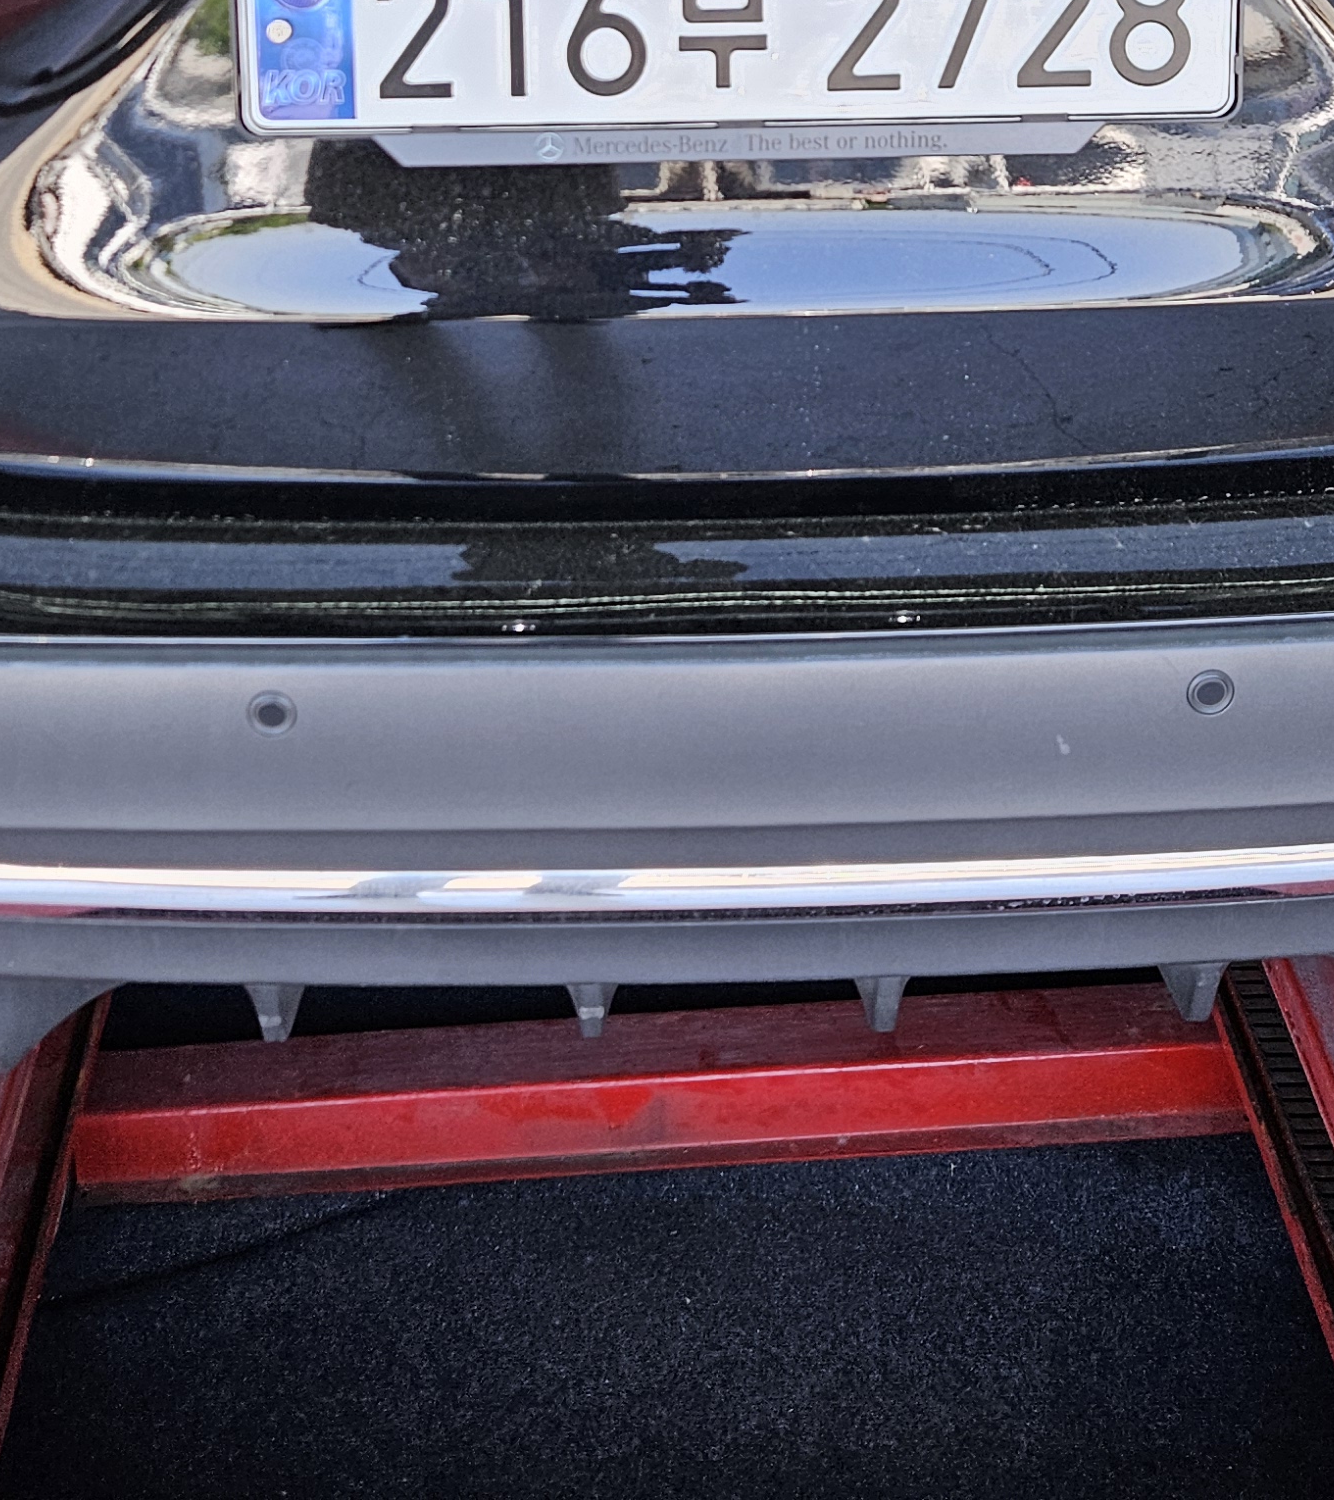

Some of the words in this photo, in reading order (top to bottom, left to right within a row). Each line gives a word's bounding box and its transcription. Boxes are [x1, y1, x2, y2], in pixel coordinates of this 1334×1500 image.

[264, 68, 347, 105] KOR
[573, 131, 729, 156] Mercedes-Benz
[746, 132, 784, 153] The
[788, 130, 831, 152] best
[836, 134, 859, 151] or
[864, 129, 950, 153] nothing.
